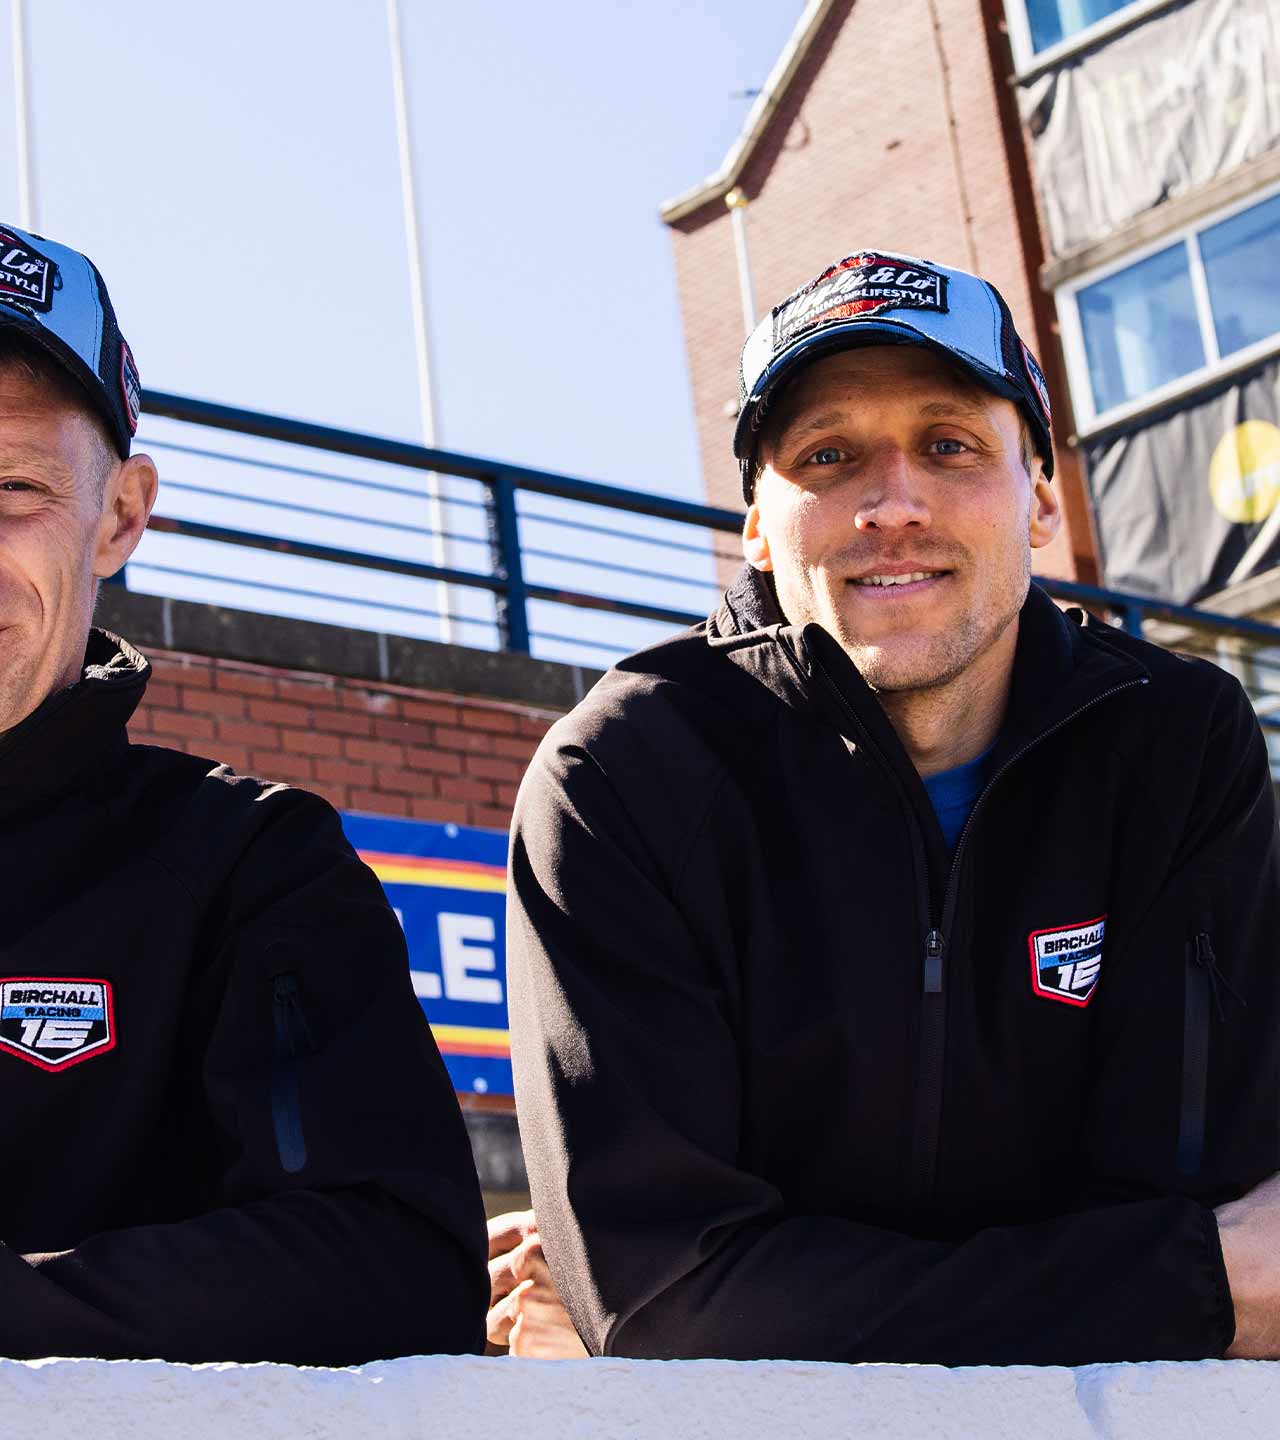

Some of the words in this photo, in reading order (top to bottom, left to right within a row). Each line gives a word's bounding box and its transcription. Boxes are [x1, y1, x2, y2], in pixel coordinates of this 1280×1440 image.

[859, 288, 935, 304] LIFESTYLE
[9, 989, 99, 1006] BIRCHALL
[24, 1006, 82, 1018] RACING
